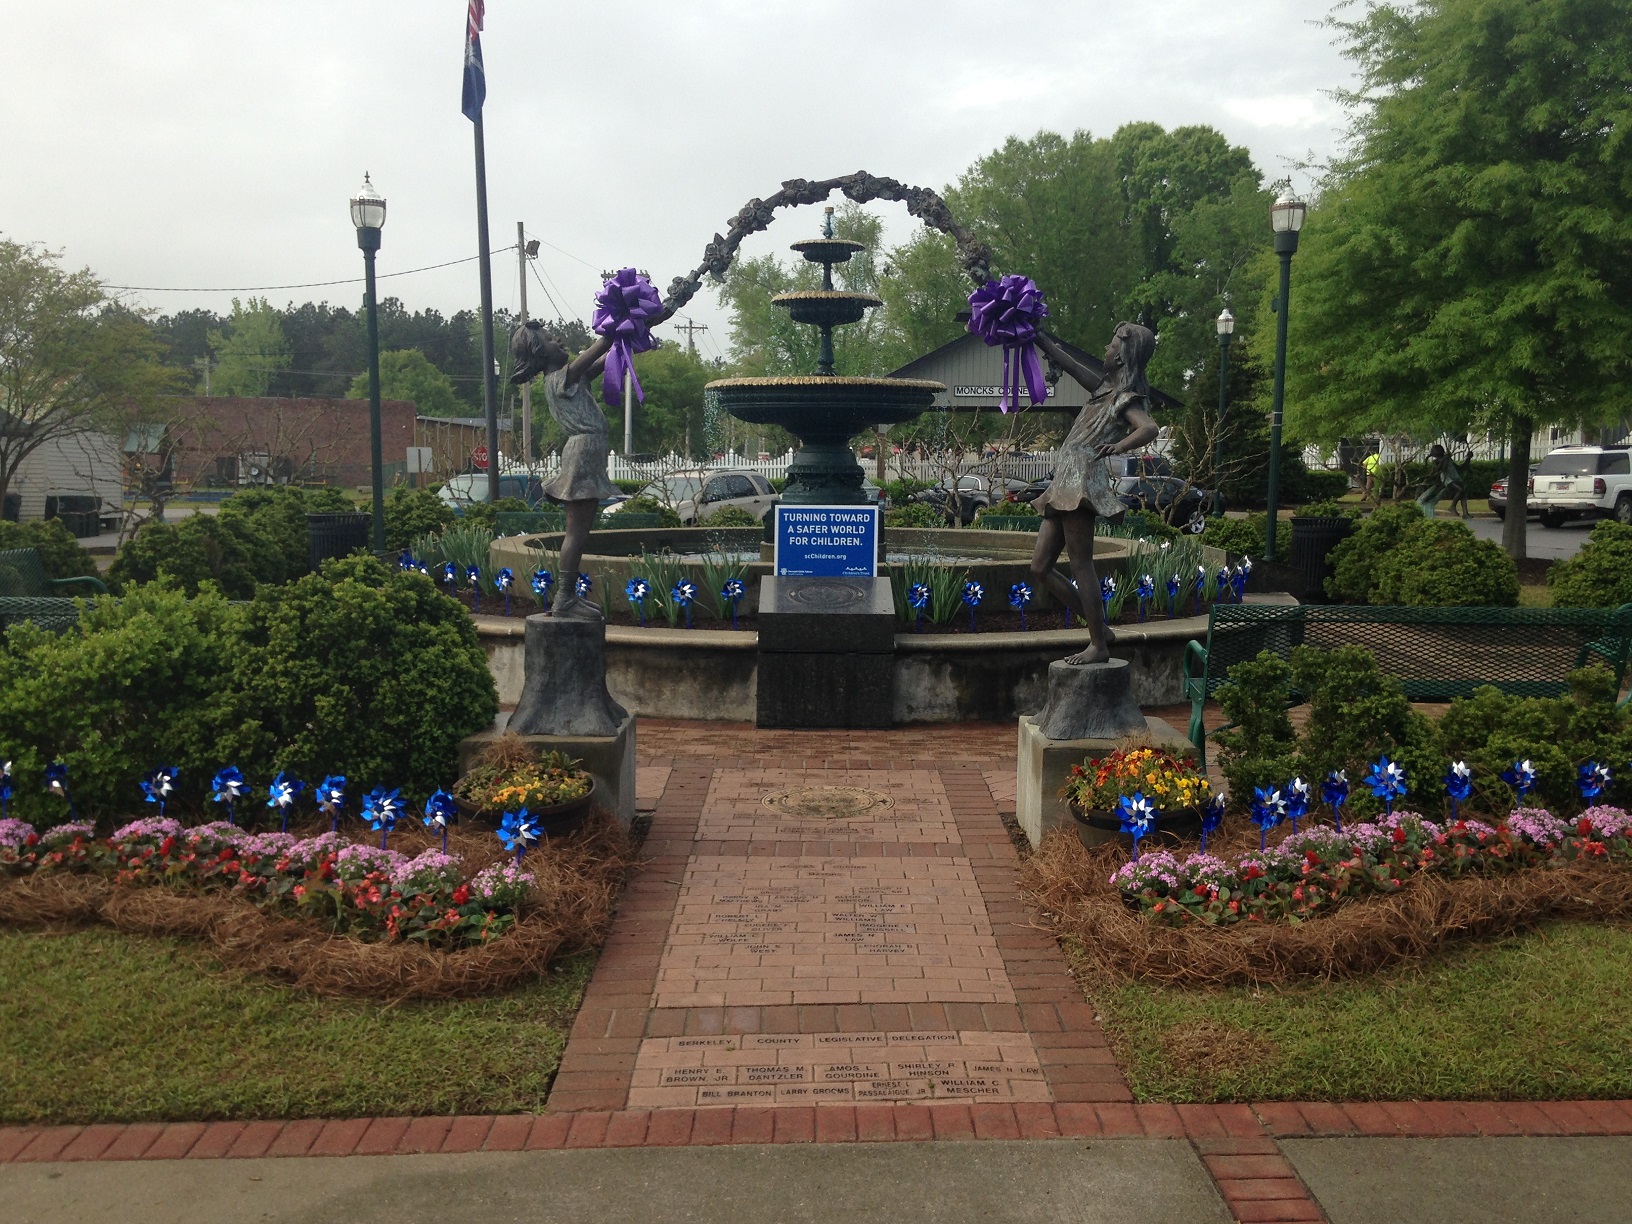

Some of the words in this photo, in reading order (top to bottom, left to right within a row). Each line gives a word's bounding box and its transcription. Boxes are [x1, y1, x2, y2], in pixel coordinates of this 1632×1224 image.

[956, 387, 994, 395] MONCKS
[471, 452, 487, 462] STO
[783, 513, 827, 522] TURNING
[829, 513, 870, 523] TOWARD
[787, 525, 795, 534] A
[796, 525, 828, 534] SAFER
[830, 525, 866, 534] WORLD
[789, 536, 809, 545] FOR
[811, 537, 863, 546] CHILDREN.
[804, 553, 847, 561] scChildren.org
[678, 1039, 732, 1047] BERKELEY
[897, 1063, 941, 1071] SHIRLEY
[908, 1069, 950, 1077] HINSON
[871, 1081, 900, 1089] ERNEST
[727, 1090, 772, 1098] BRANTON
[780, 1088, 808, 1096] LARRY
[812, 1087, 850, 1095] GROOMS
